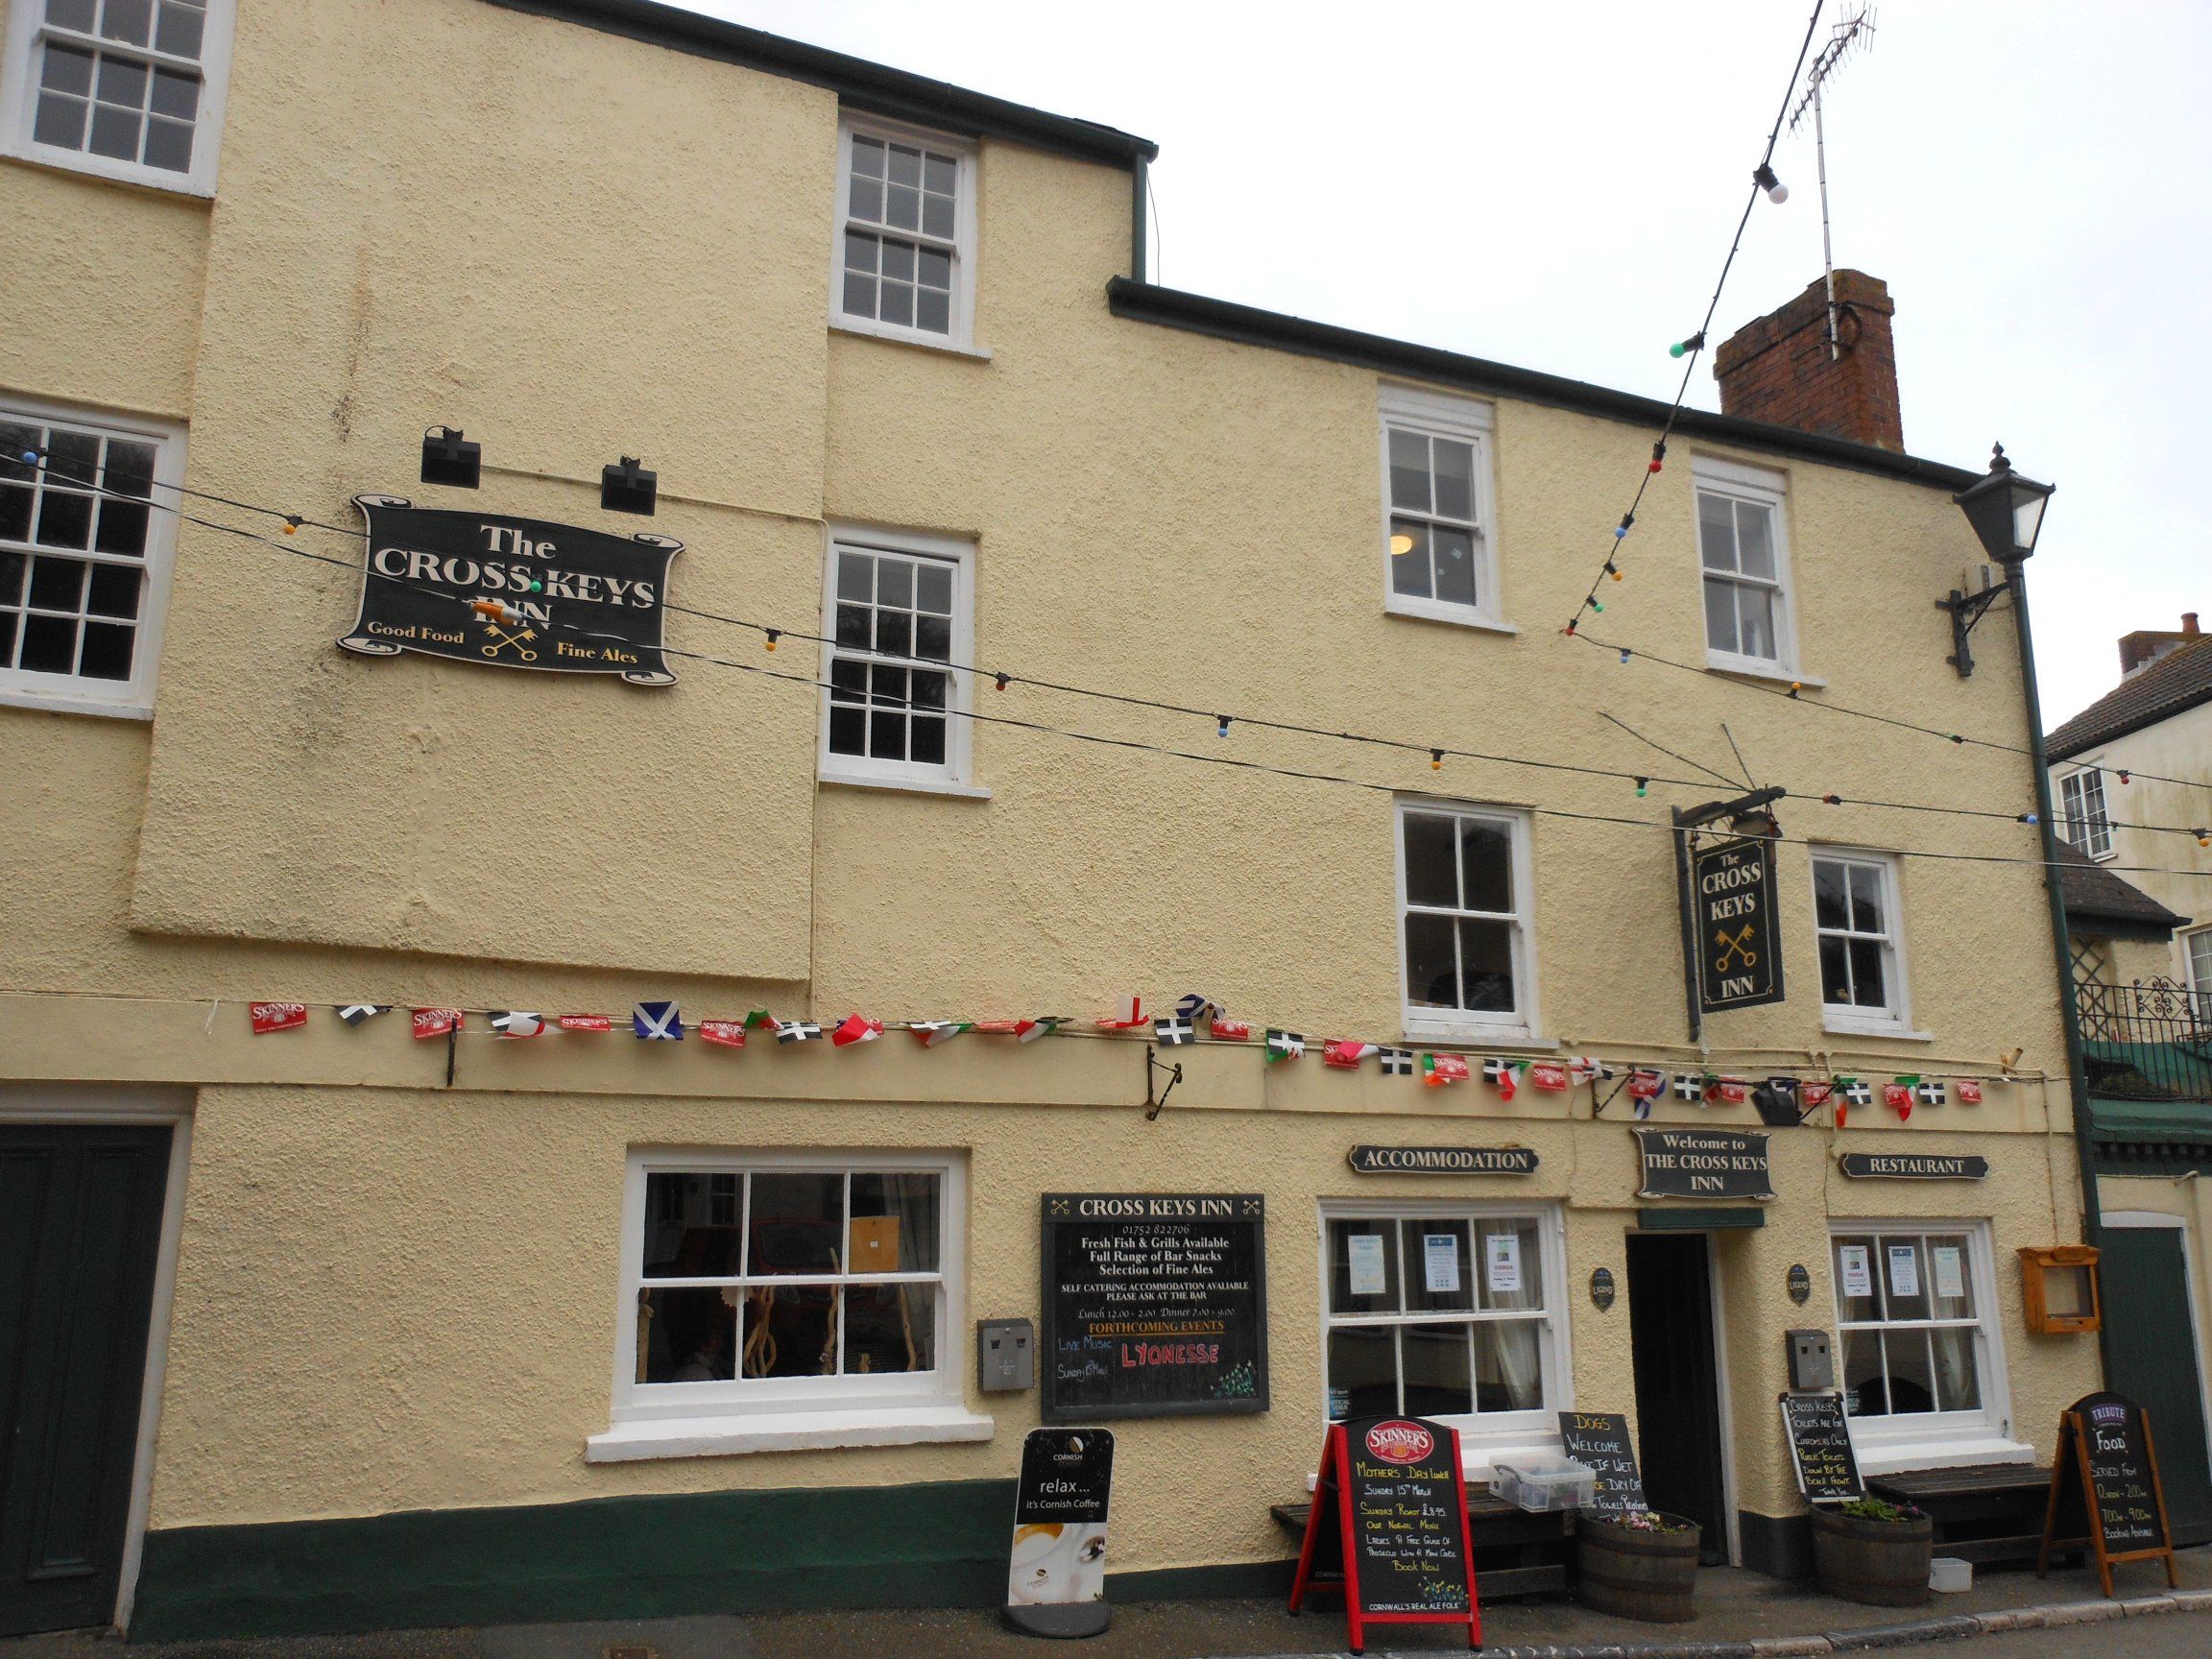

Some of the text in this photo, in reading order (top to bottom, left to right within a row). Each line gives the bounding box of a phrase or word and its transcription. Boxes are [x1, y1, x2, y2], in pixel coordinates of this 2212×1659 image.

[481, 524, 556, 559] The
[374, 547, 655, 609] CROSS KEYS
[367, 621, 464, 644] Good Food
[557, 642, 638, 664] Fine Ales
[1720, 854, 1740, 867] The
[1702, 862, 1762, 894] CROSS
[1710, 893, 1755, 921] KEYS
[1721, 975, 1754, 998] INN
[1663, 1135, 1746, 1150] Welcome to
[1364, 1150, 1528, 1169] ACCOMMODATION
[1646, 1153, 1767, 1170] THE CROSS KEYS
[1870, 1158, 1964, 1173] RESTAURANT
[1691, 1176, 1724, 1190] INN
[1079, 1199, 1233, 1215] CROSS KEYS INN
[1122, 1224, 1190, 1236] 01752 822706
[1081, 1237, 1229, 1248] Fresh Fish & Grills Available
[1090, 1250, 1222, 1264] Full Range of Bar Snacks
[1099, 1263, 1214, 1275] Selection of Fine Ales
[1061, 1284, 1081, 1292] SELF
[1083, 1283, 1127, 1292] CATERING
[1128, 1282, 1205, 1291] ACCOMMODATION
[1106, 1292, 1137, 1301] PLEASE
[1170, 1291, 1188, 1300] THE
[1190, 1291, 1207, 1300] BAR
[1089, 1320, 1225, 1334] FORTHCOMING EVENTS
[1121, 1342, 1219, 1367] LYONESSE
[2092, 1406, 2126, 1421] TRIBUTE
[1574, 1414, 1611, 1431] DOGS
[1566, 1432, 1623, 1454] WELCOME
[1053, 1453, 1083, 1461] CORNISH
[1612, 1458, 1633, 1472] WET
[1026, 1499, 1100, 1509] it's Cornish Coffee
[1429, 1601, 1441, 1610] ALE
